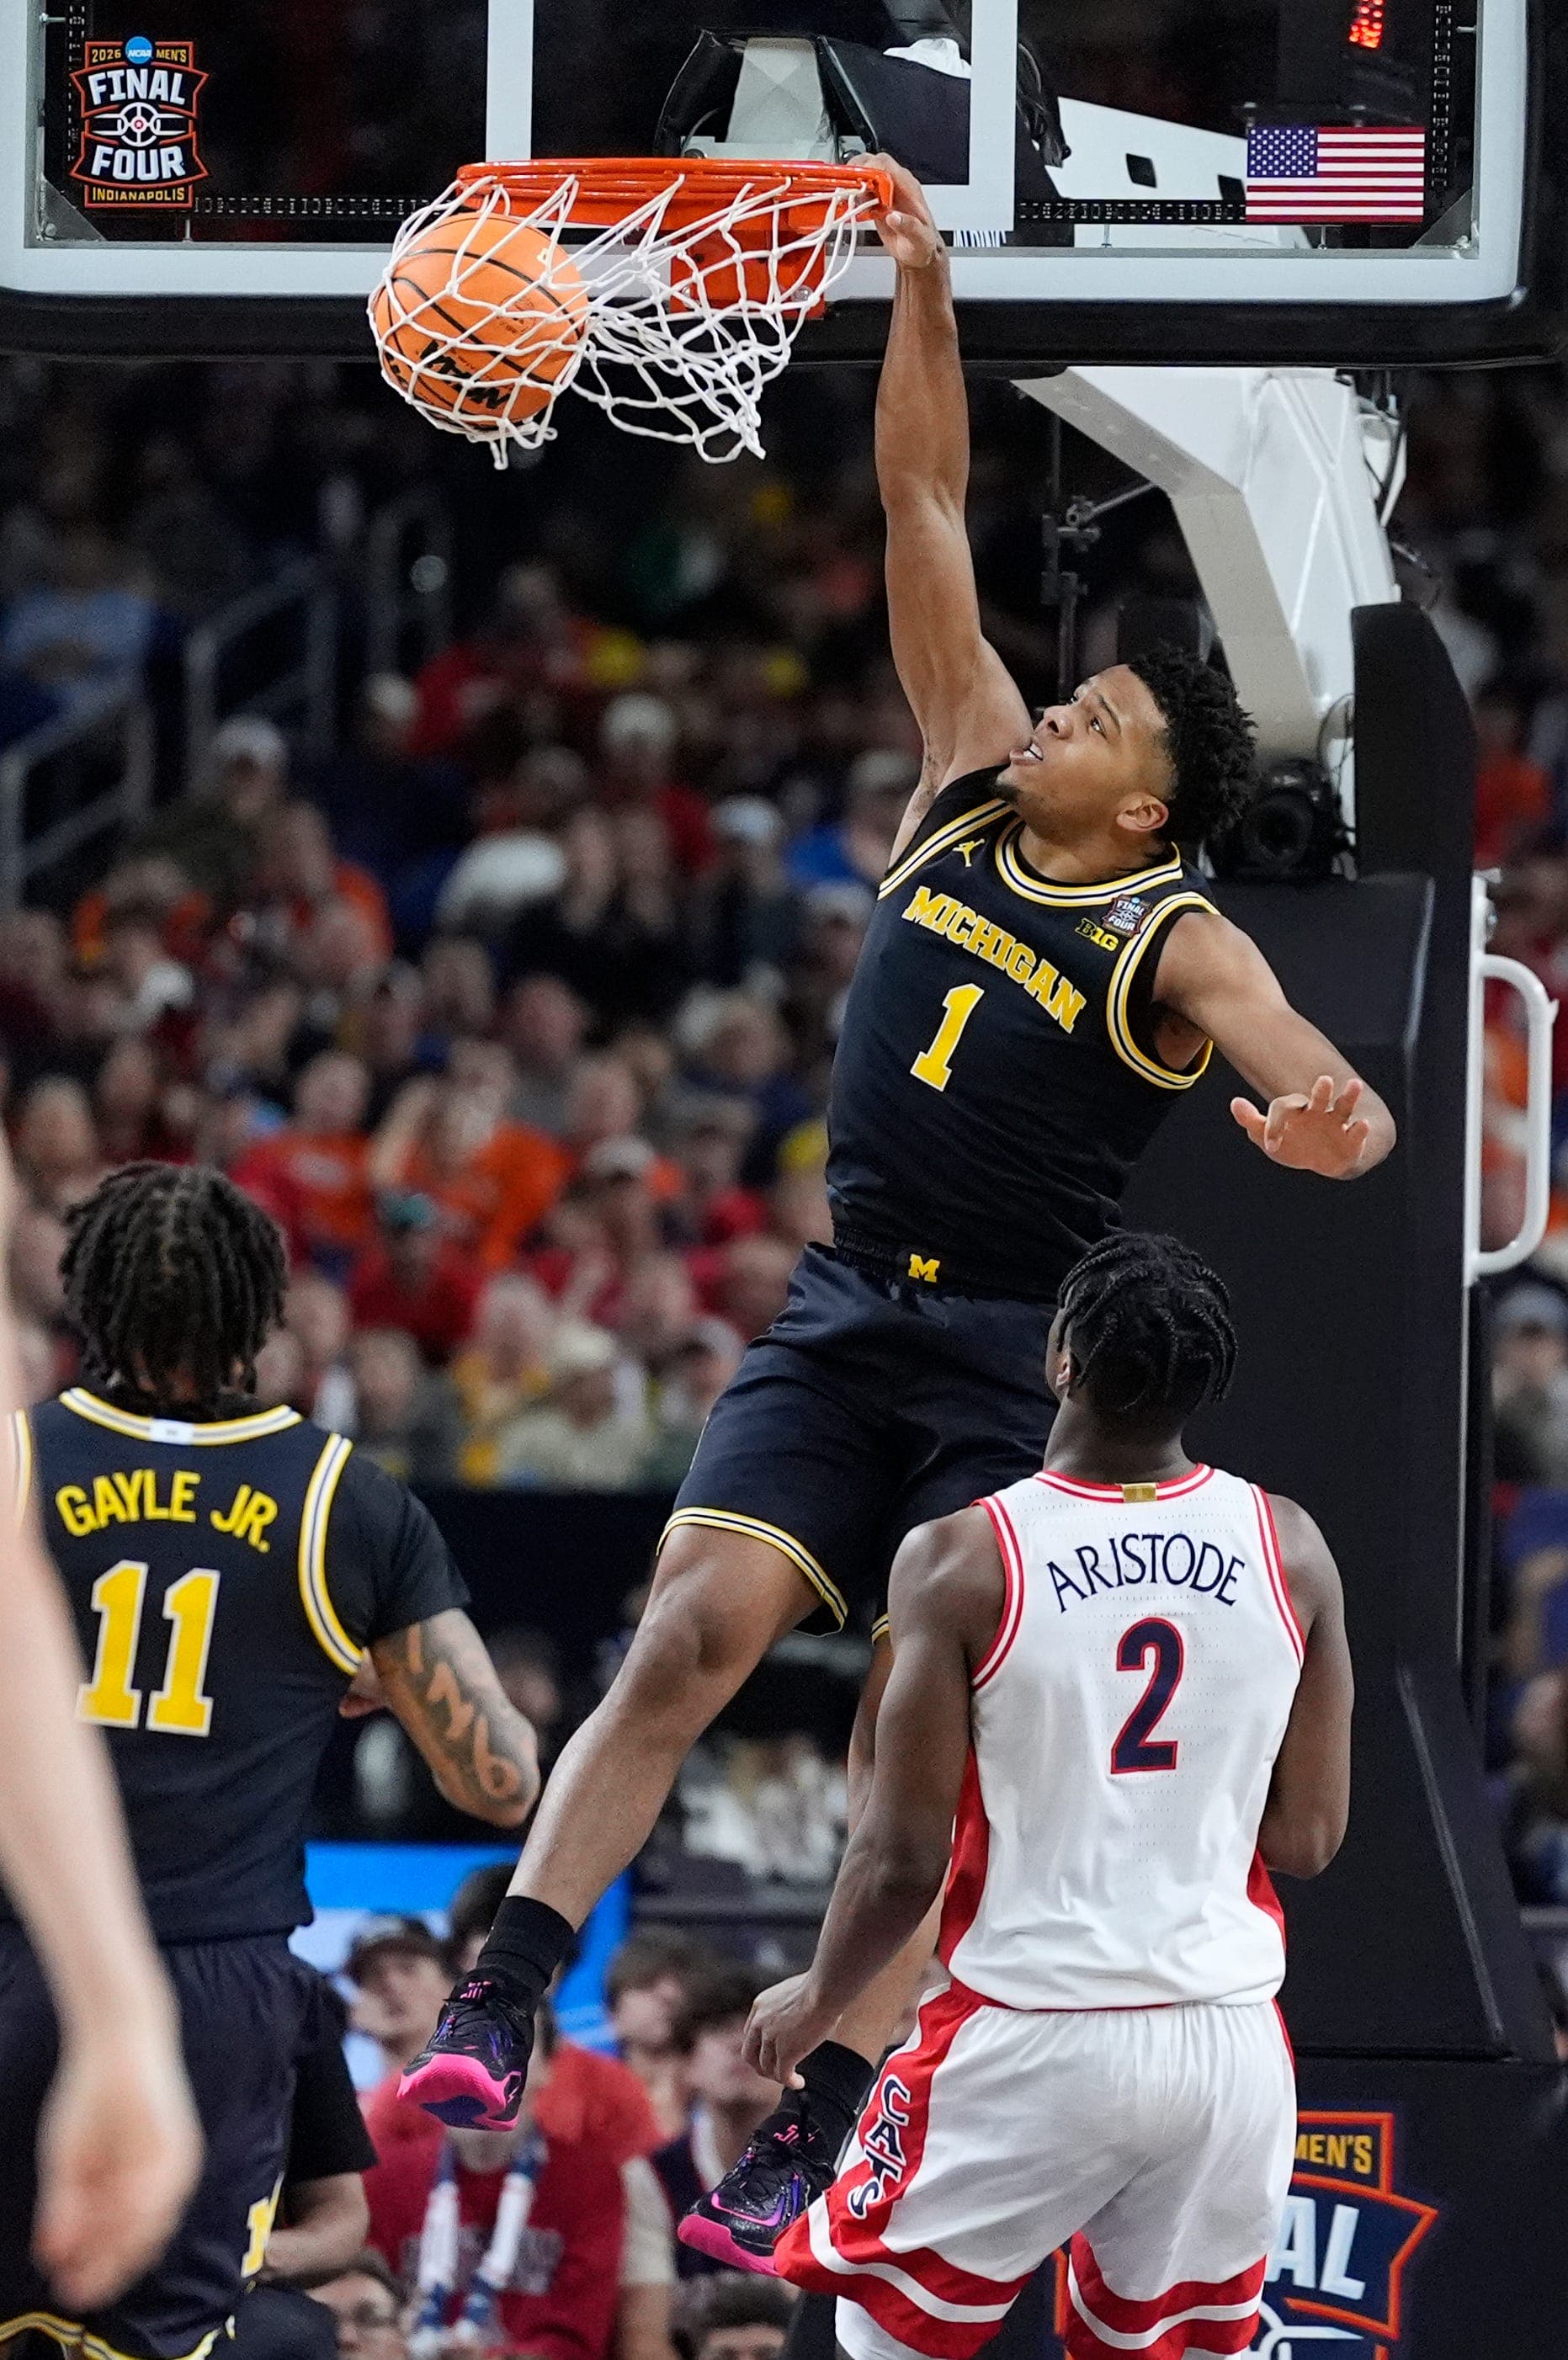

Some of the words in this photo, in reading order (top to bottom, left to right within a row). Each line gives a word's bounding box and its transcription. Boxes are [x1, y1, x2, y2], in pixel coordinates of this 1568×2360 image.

[92, 49, 122, 62] 2026
[126, 49, 152, 58] NCAA
[156, 49, 187, 63] MEN'S
[88, 68, 186, 106] FINAL
[91, 144, 187, 181] FOUR
[93, 187, 185, 201] INDIANAPOLIS
[1108, 915, 1136, 931] FOUR
[1116, 900, 1145, 916] FINAL
[901, 885, 1087, 1034] MICHIGAN
[910, 983, 985, 1092] 1
[908, 1253, 940, 1283] M
[55, 1468, 201, 1537] GAYLE
[210, 1484, 279, 1553] JR.
[1047, 1533, 1246, 1613] ARISTODE
[77, 1560, 221, 1737] 11
[1110, 1617, 1184, 1774] 2
[848, 2074, 912, 2219] CATS
